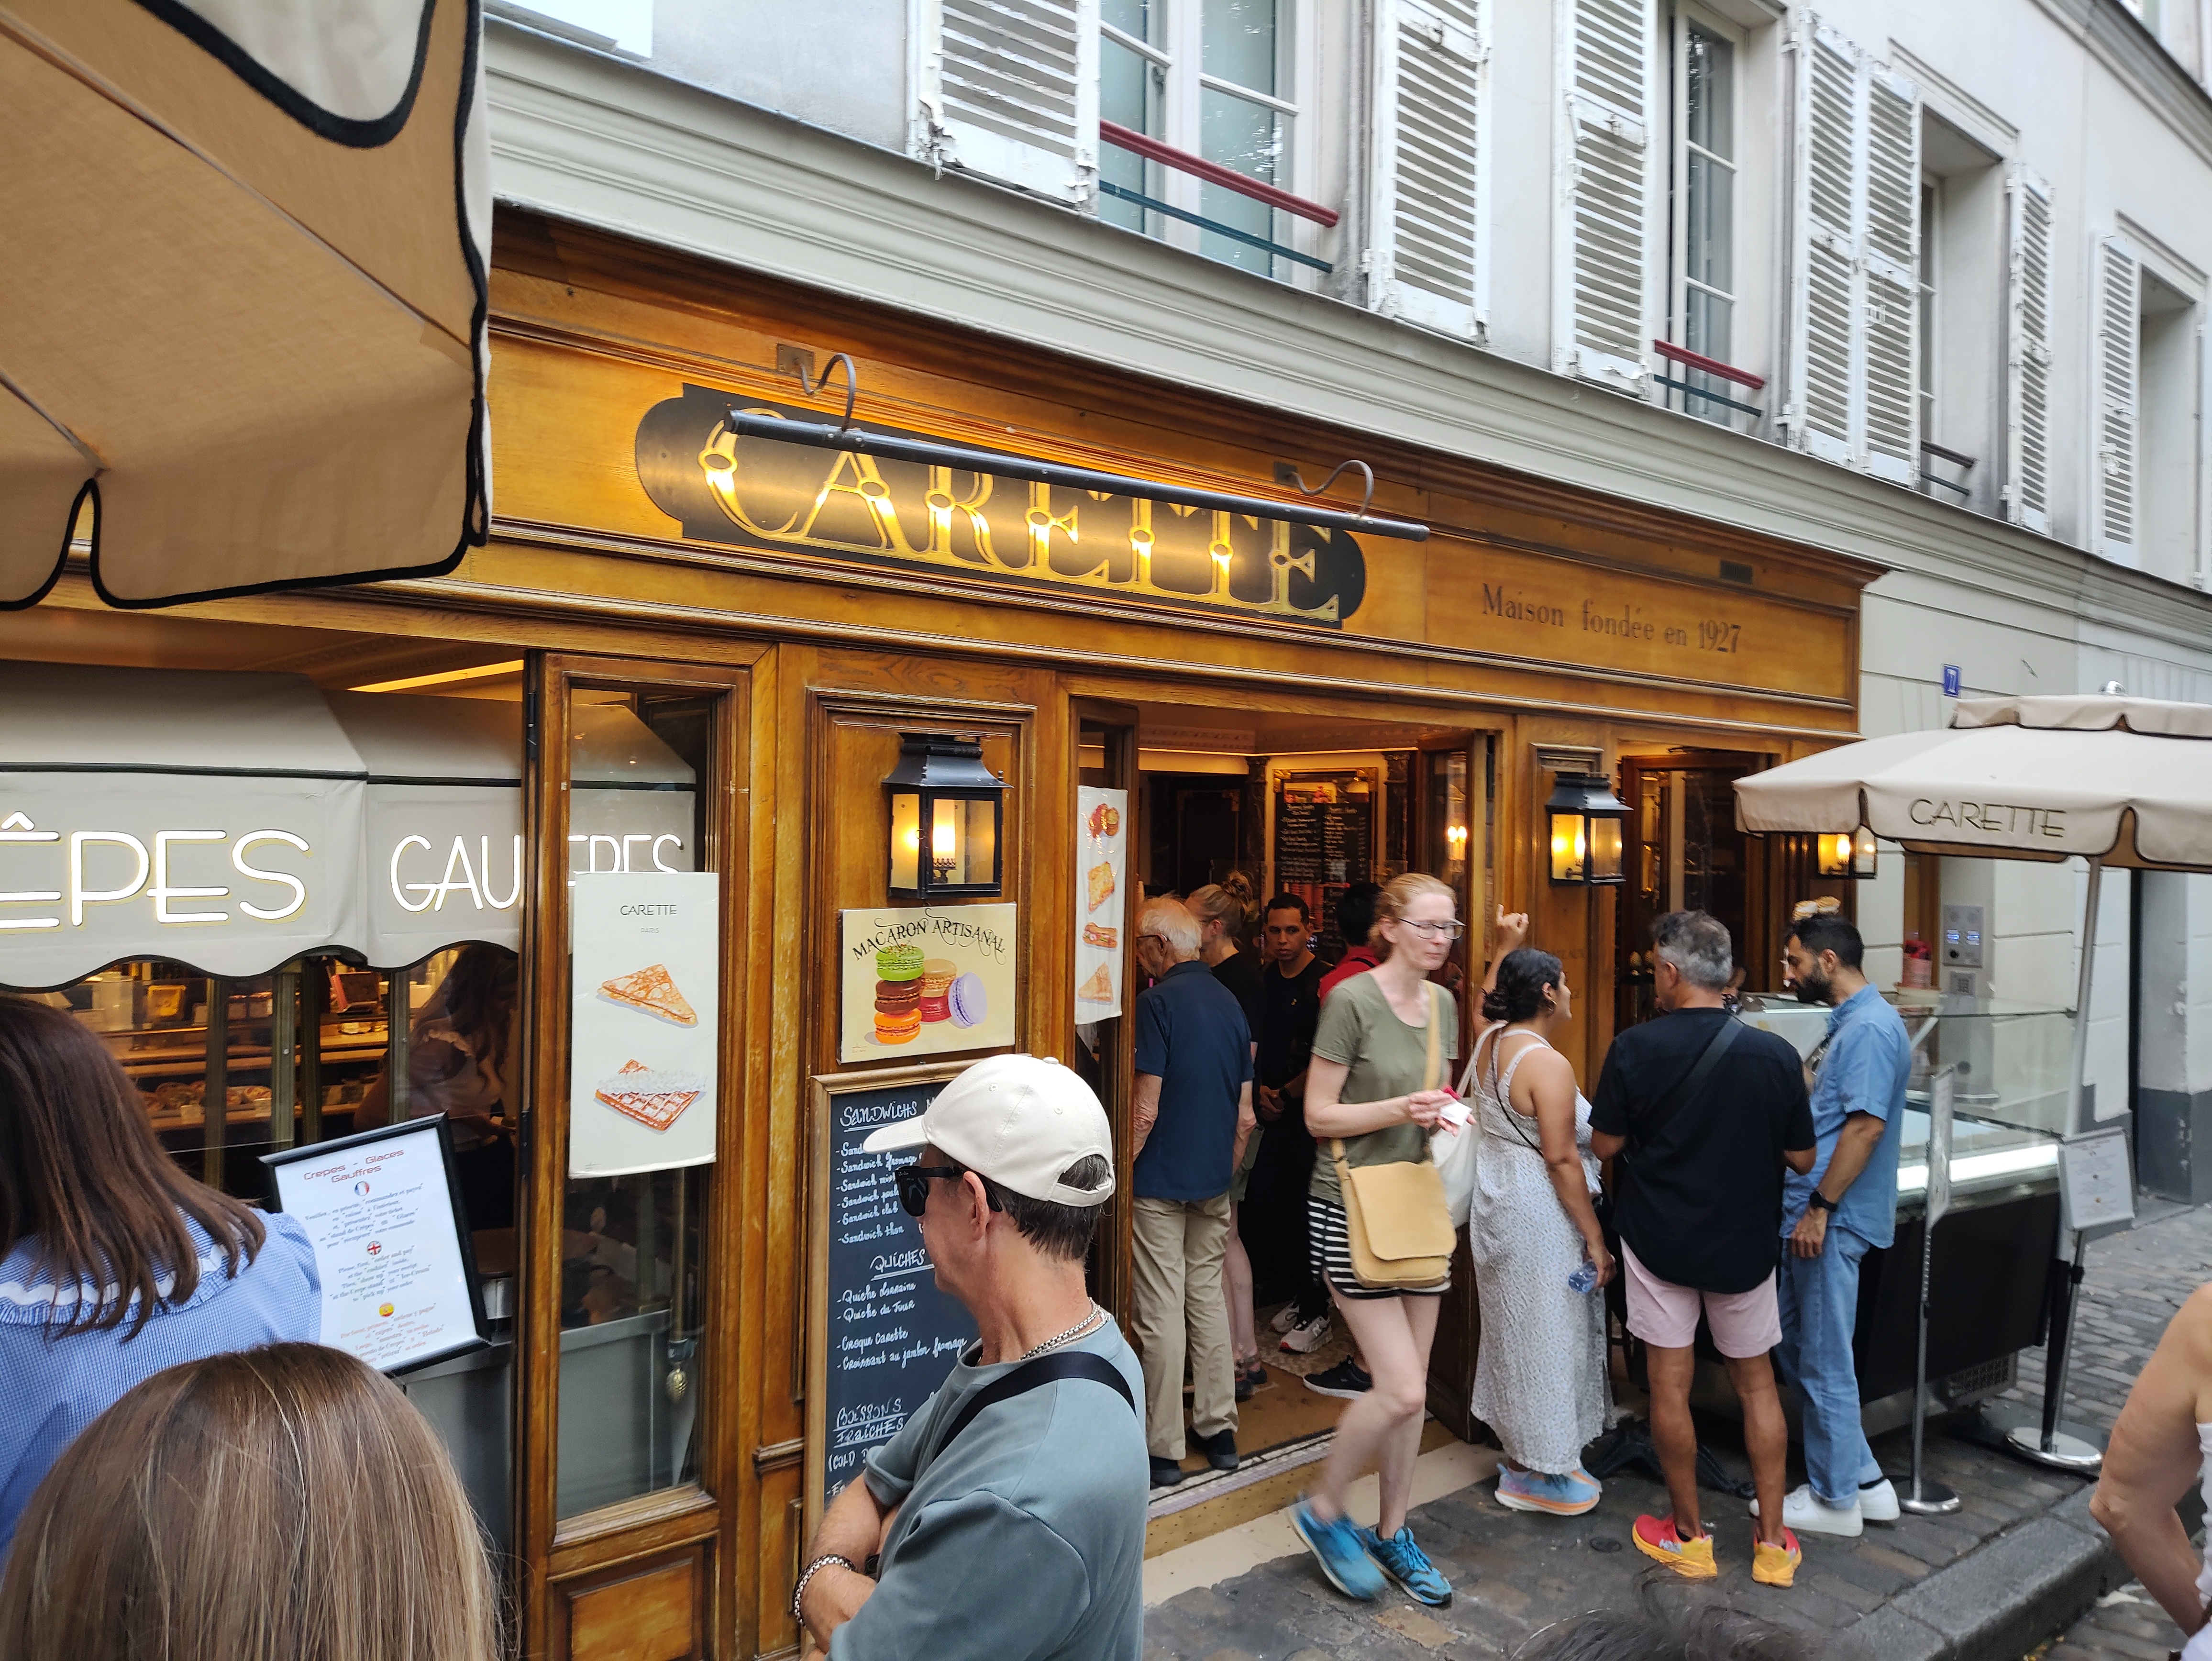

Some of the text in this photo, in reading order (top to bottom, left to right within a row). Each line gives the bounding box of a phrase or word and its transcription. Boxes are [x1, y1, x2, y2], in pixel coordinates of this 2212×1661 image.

[697, 407, 1339, 621] CARETTE
[1482, 582, 1741, 653] Maison fondée en 1927
[1908, 797, 2068, 838] CARETTE
[620, 904, 677, 915] CARETTE
[852, 908, 1006, 965] MACARON ARTISANAL
[304, 1165, 345, 1180] Crepes
[365, 1150, 404, 1164] Glaces
[332, 1165, 381, 1183] Gauffres
[882, 1201, 899, 1215] club
[885, 1222, 904, 1236] thon
[870, 1248, 926, 1273] QUICHES
[880, 1304, 891, 1316] du
[875, 1326, 908, 1345] Carette
[889, 1351, 900, 1362] au
[837, 1397, 902, 1428] BOISSONS
